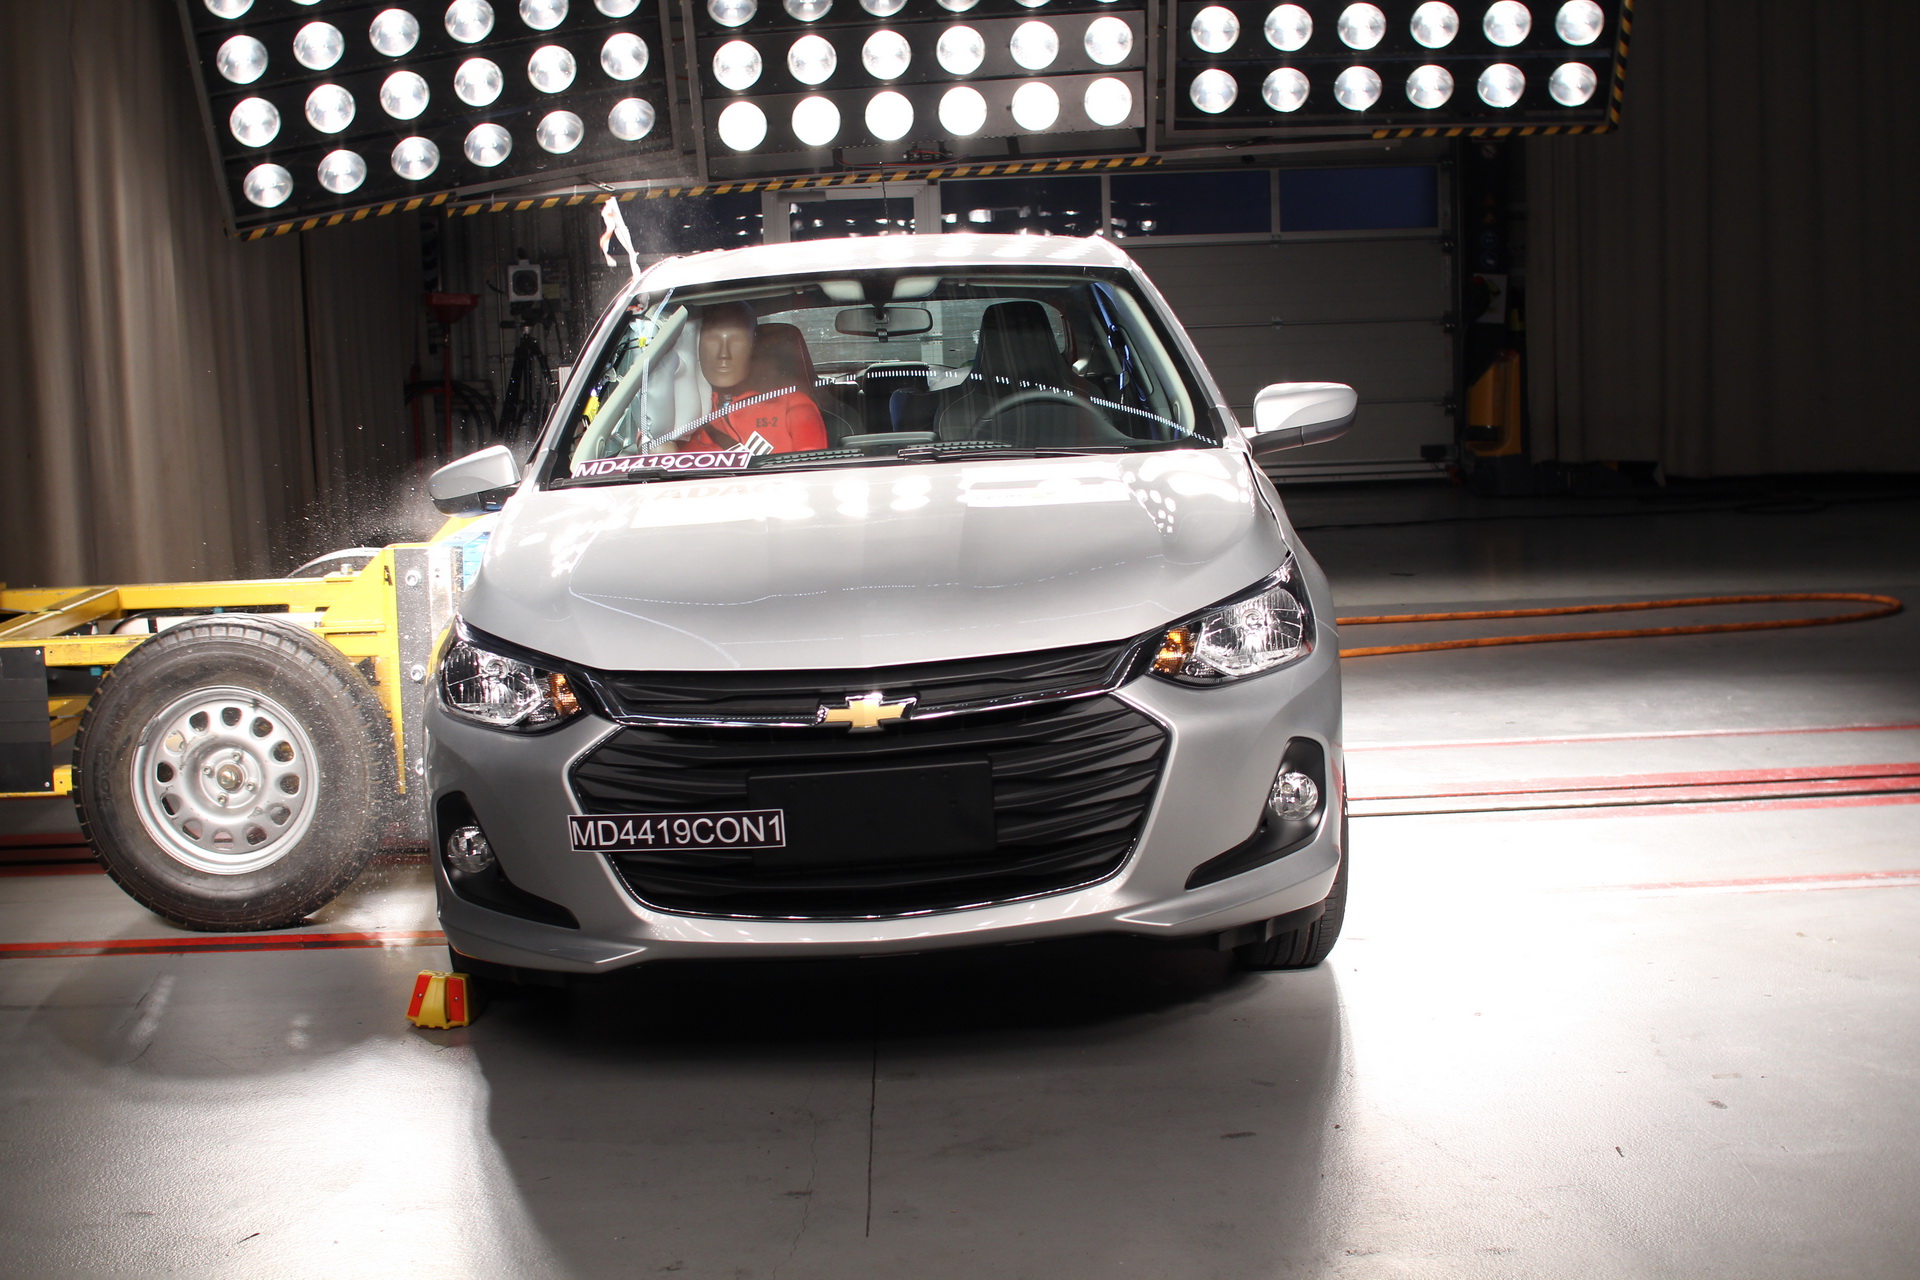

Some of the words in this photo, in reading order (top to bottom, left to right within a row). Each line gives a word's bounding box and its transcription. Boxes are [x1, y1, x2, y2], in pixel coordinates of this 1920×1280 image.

[755, 416, 779, 428] ES-2
[577, 453, 748, 477] MD4419CON1
[571, 815, 782, 846] MD4419CON1
